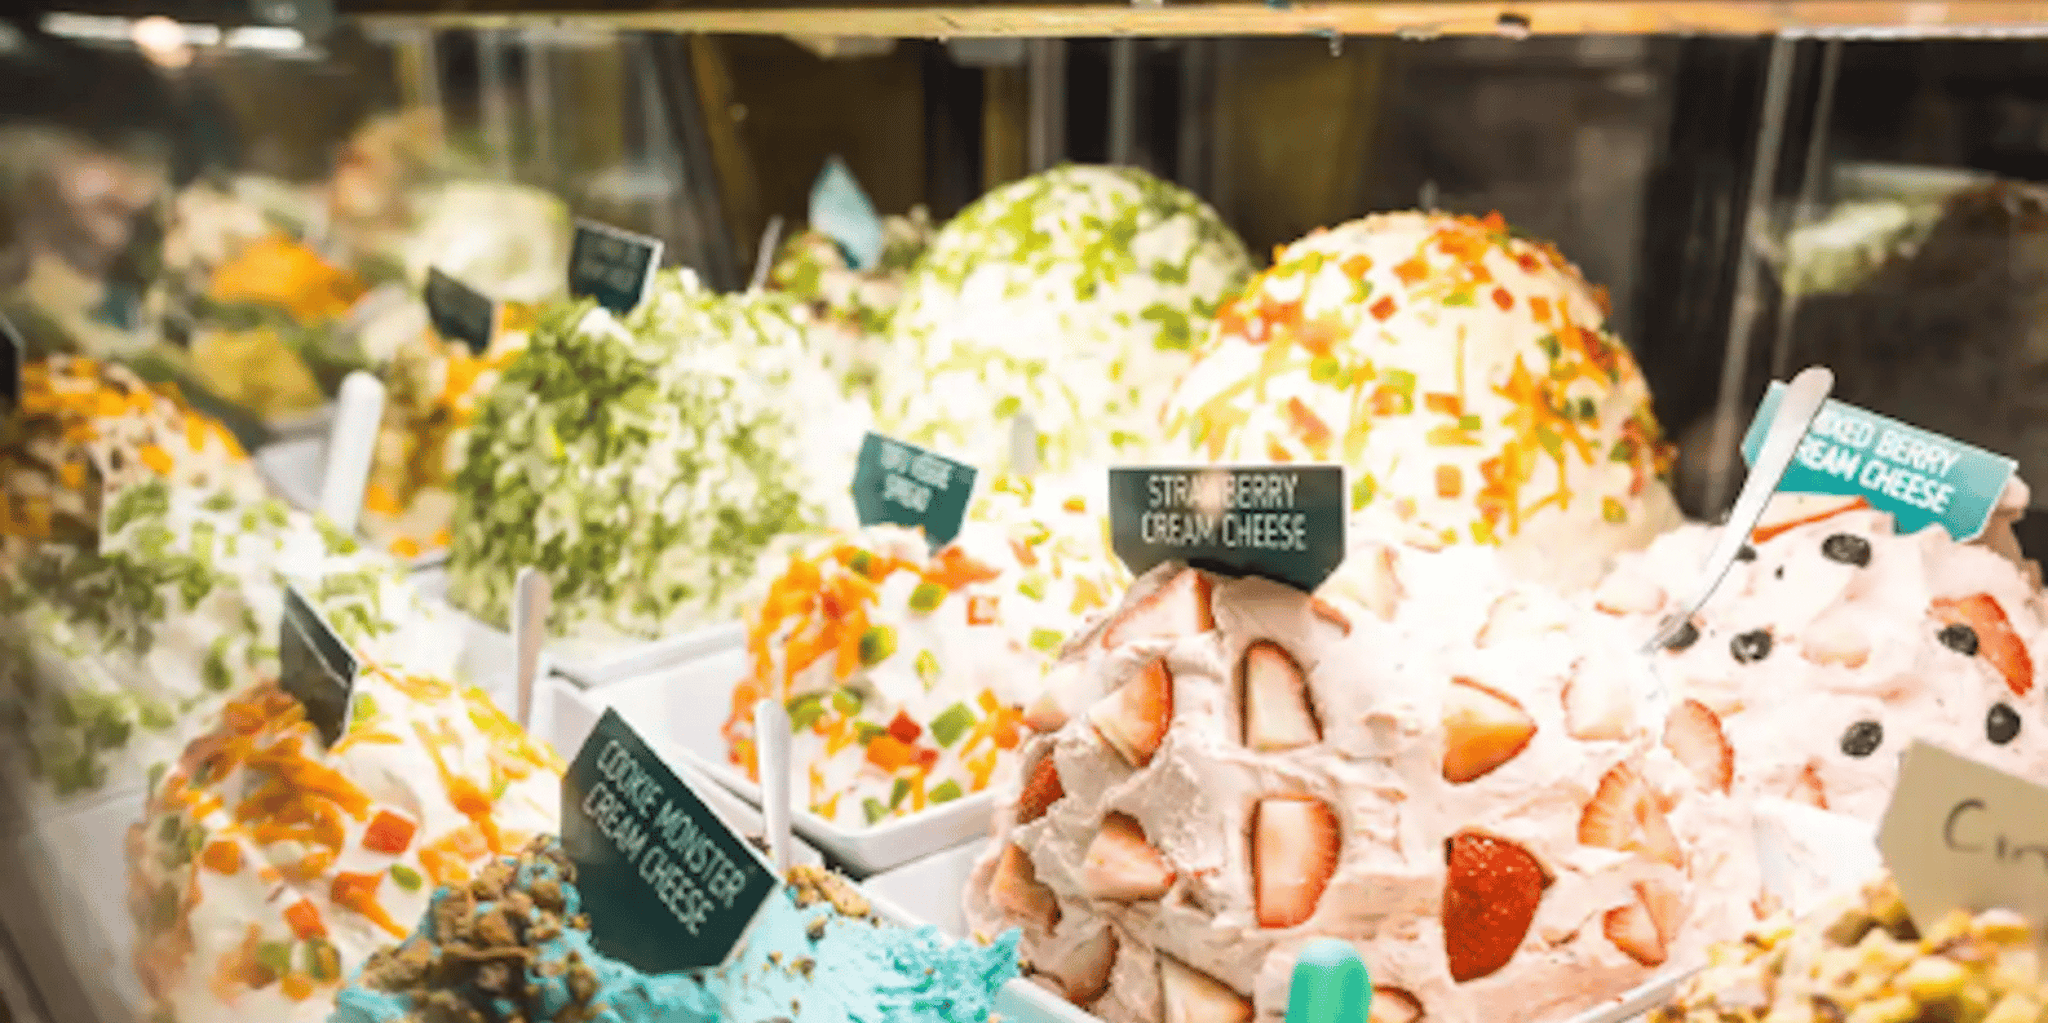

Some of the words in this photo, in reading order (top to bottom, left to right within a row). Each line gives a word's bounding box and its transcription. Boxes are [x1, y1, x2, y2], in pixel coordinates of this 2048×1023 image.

[1877, 428, 1961, 478] BERRY
[1147, 473, 1299, 509] STRABERRY
[1859, 459, 1956, 514] CHEESE
[1141, 511, 1217, 546] CREAM
[1222, 512, 1307, 551] CHEESE
[597, 739, 664, 817] COOKIE
[653, 799, 747, 909] MONSTER
[582, 781, 650, 863] CREAM
[638, 846, 715, 936] CHEESE
